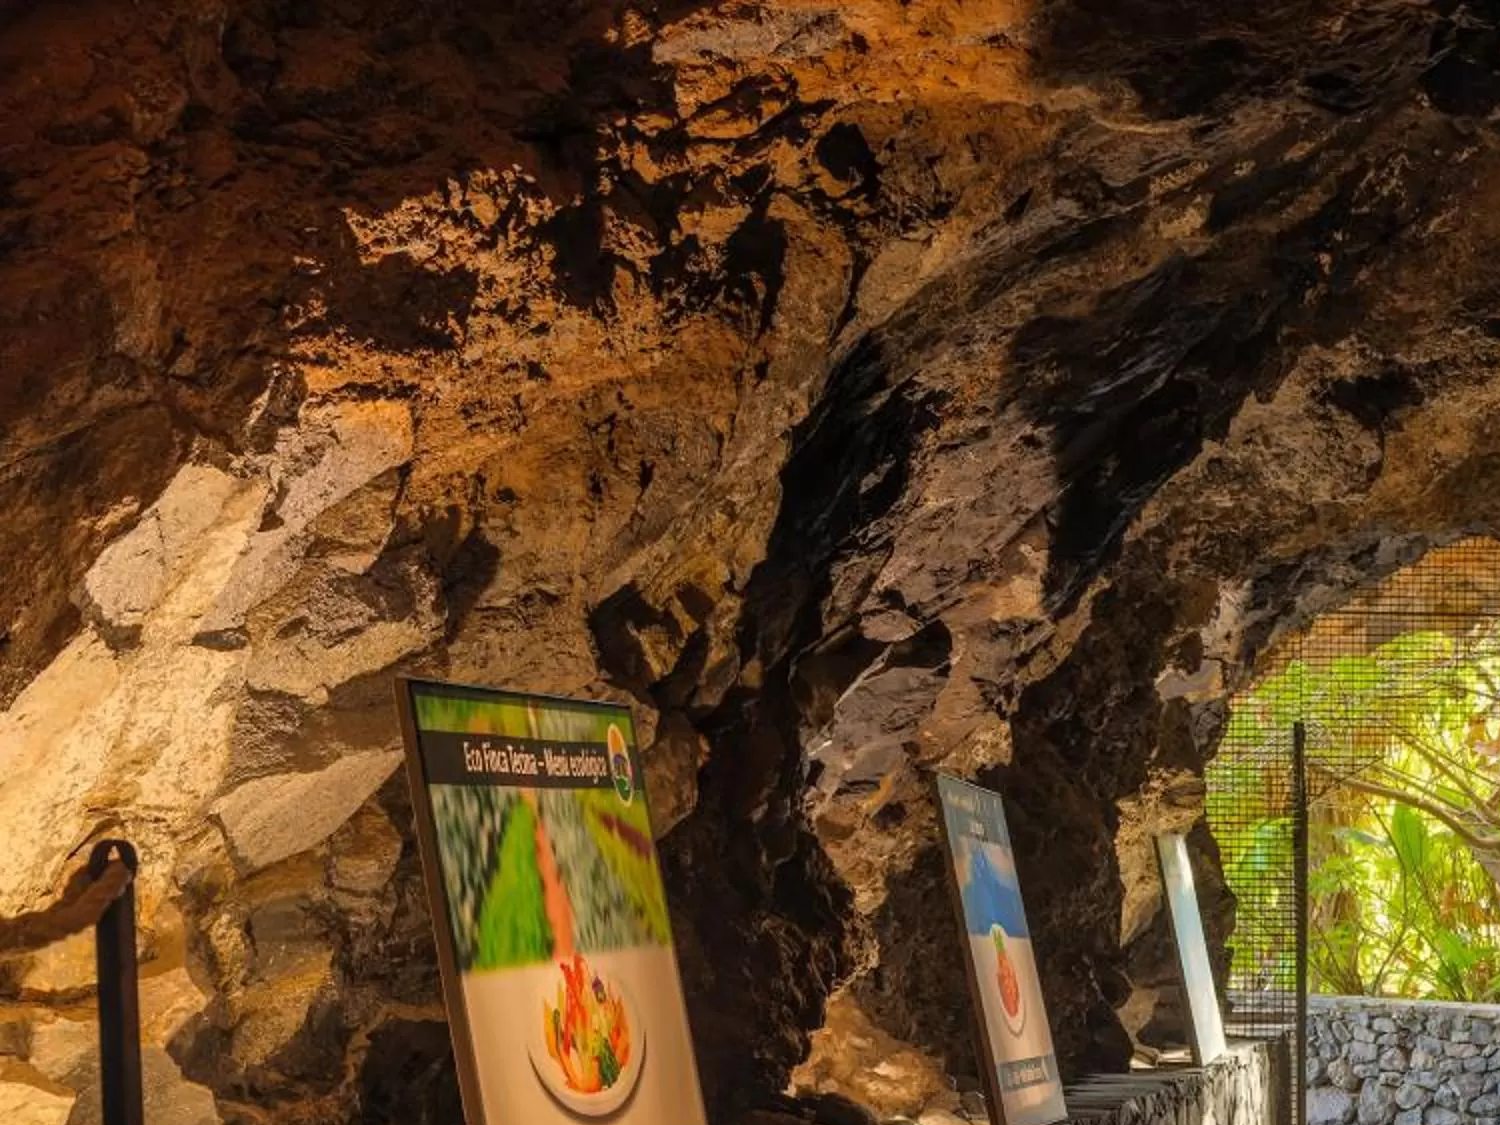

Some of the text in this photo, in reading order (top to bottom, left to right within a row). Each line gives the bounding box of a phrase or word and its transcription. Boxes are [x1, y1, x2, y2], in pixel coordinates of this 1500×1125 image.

[463, 742, 482, 773] Eco
[482, 743, 509, 774] Finca
[509, 744, 538, 775] Tecina
